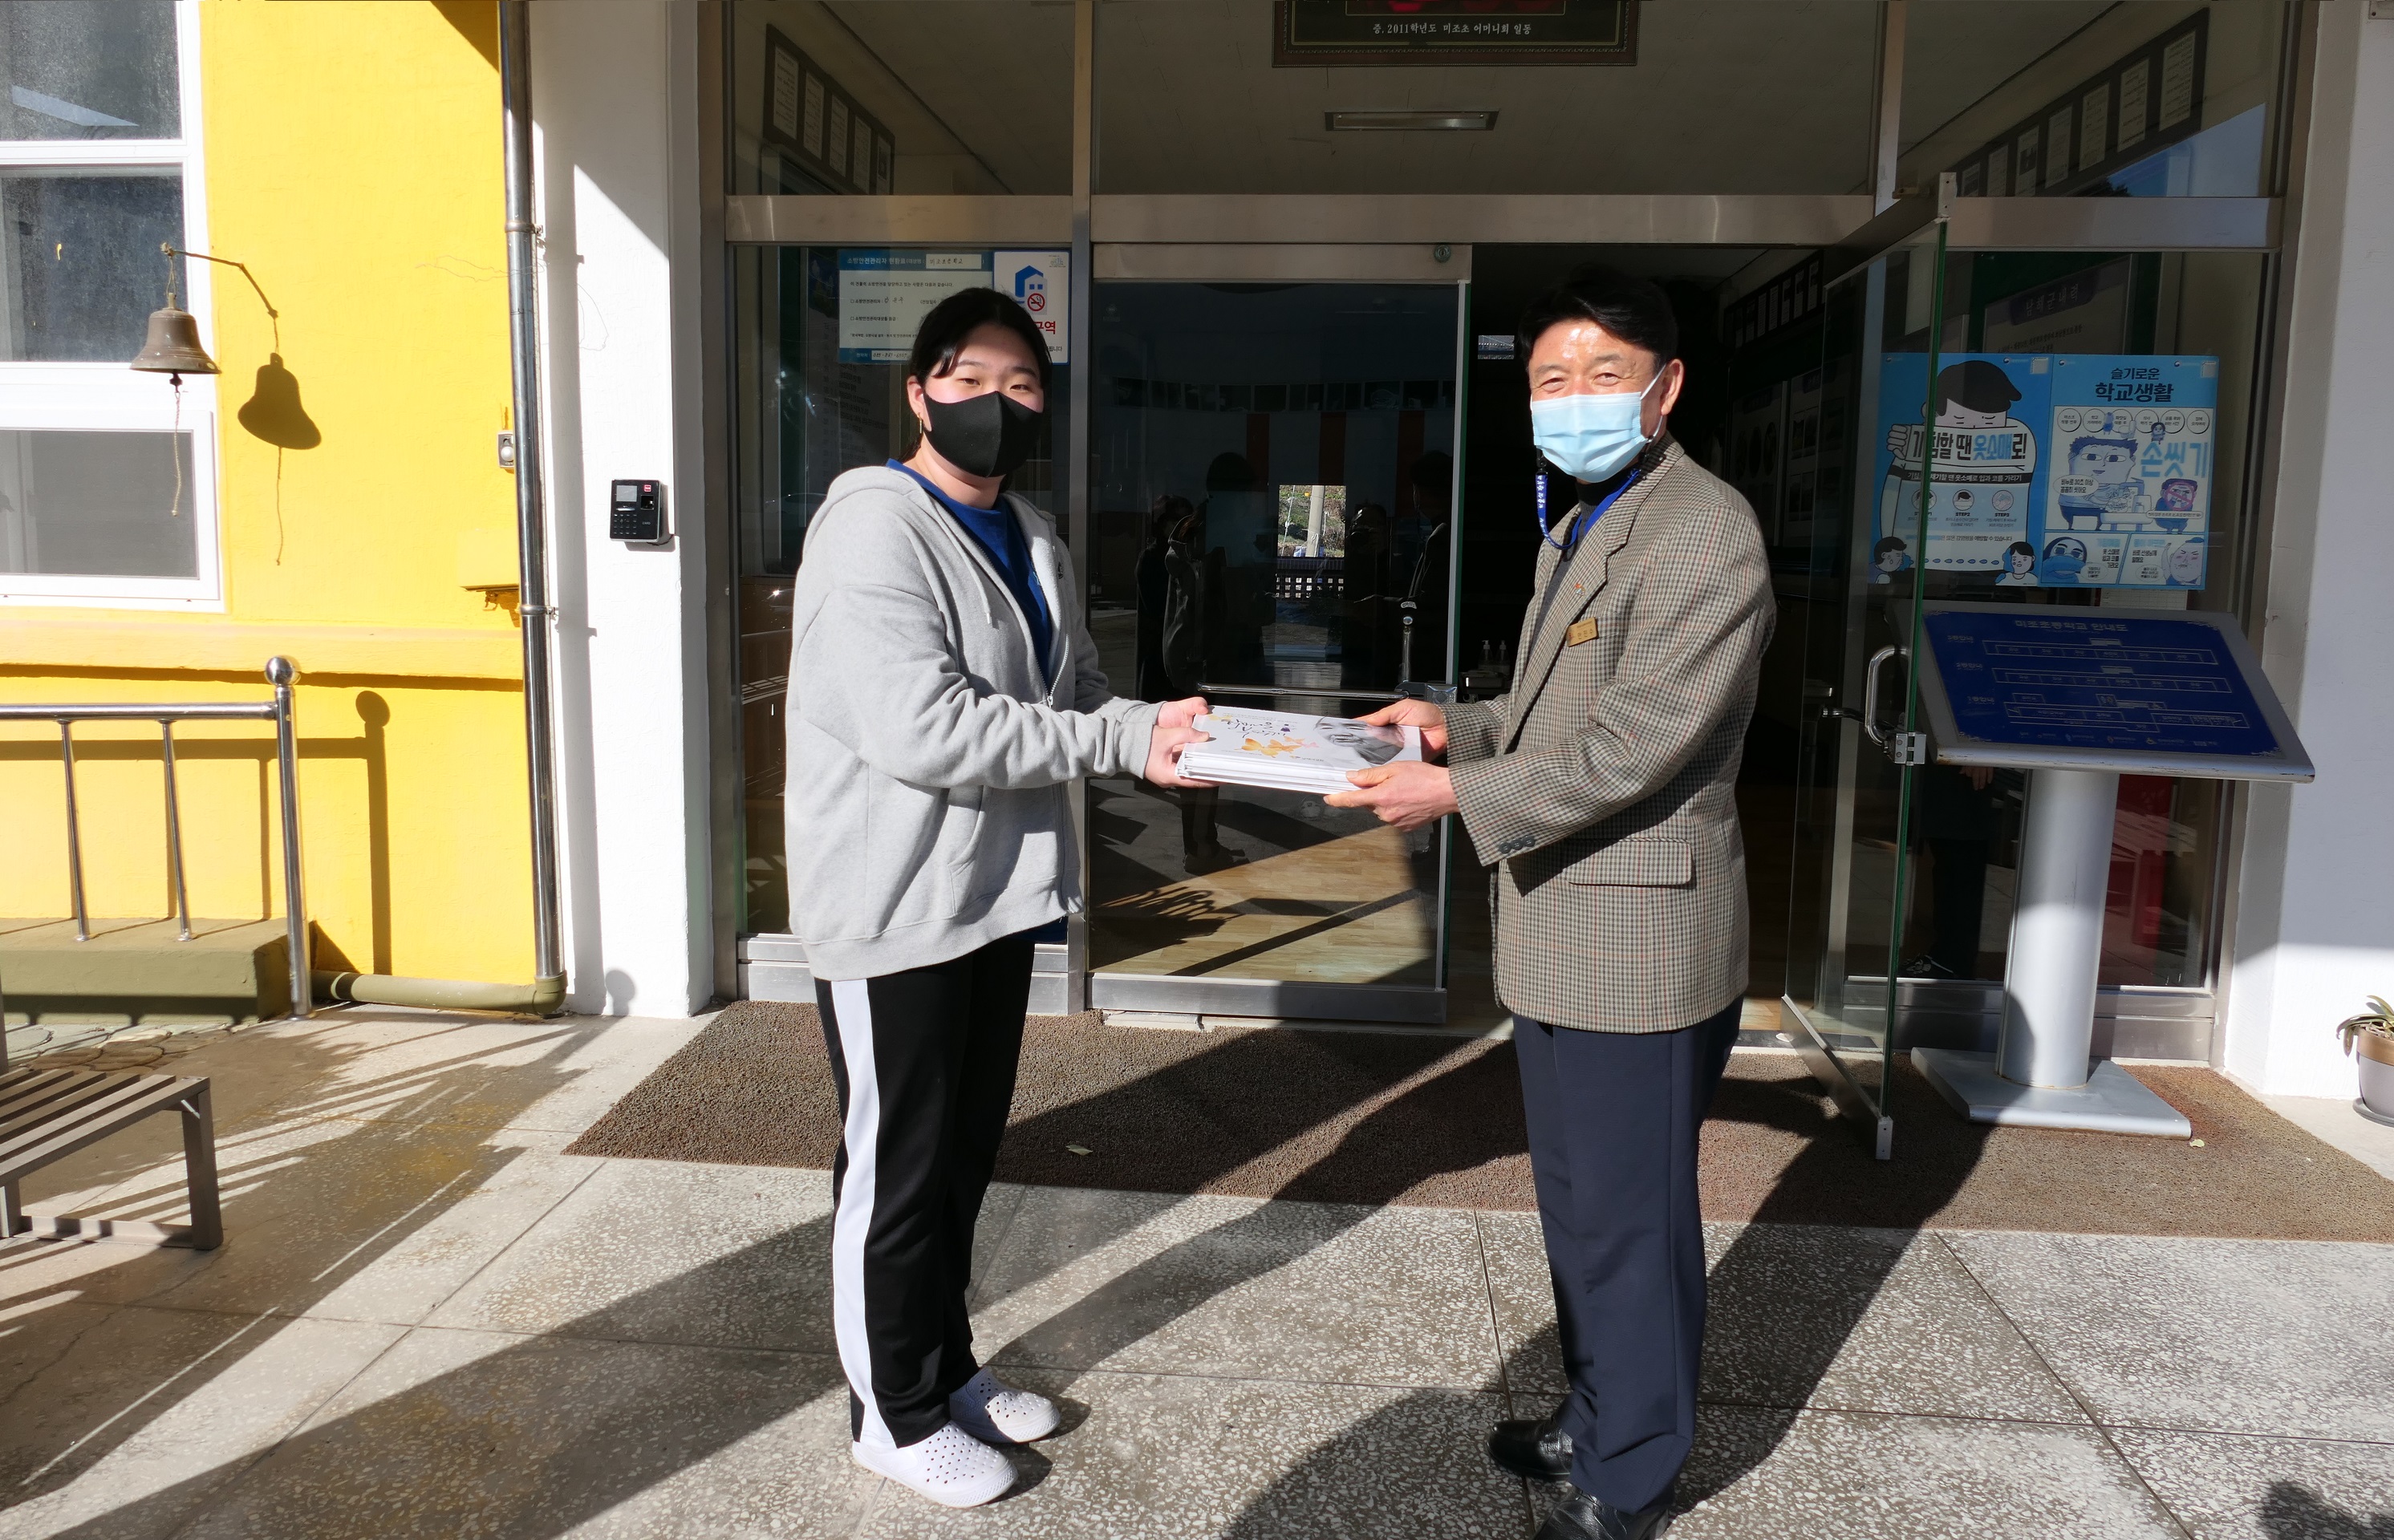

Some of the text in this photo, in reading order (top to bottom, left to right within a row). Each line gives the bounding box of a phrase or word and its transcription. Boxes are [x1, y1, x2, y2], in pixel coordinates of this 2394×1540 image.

[1387, 23, 1437, 34] 2011학년도
[1443, 23, 1470, 34] 미조초
[1474, 23, 1509, 34] 어머니회
[1514, 23, 1532, 34] 일동
[2111, 367, 2161, 380] 슬기로운
[2096, 382, 2174, 403] 학교생활
[1956, 433, 1973, 460] 땐
[2140, 441, 2209, 478] 손씻기
